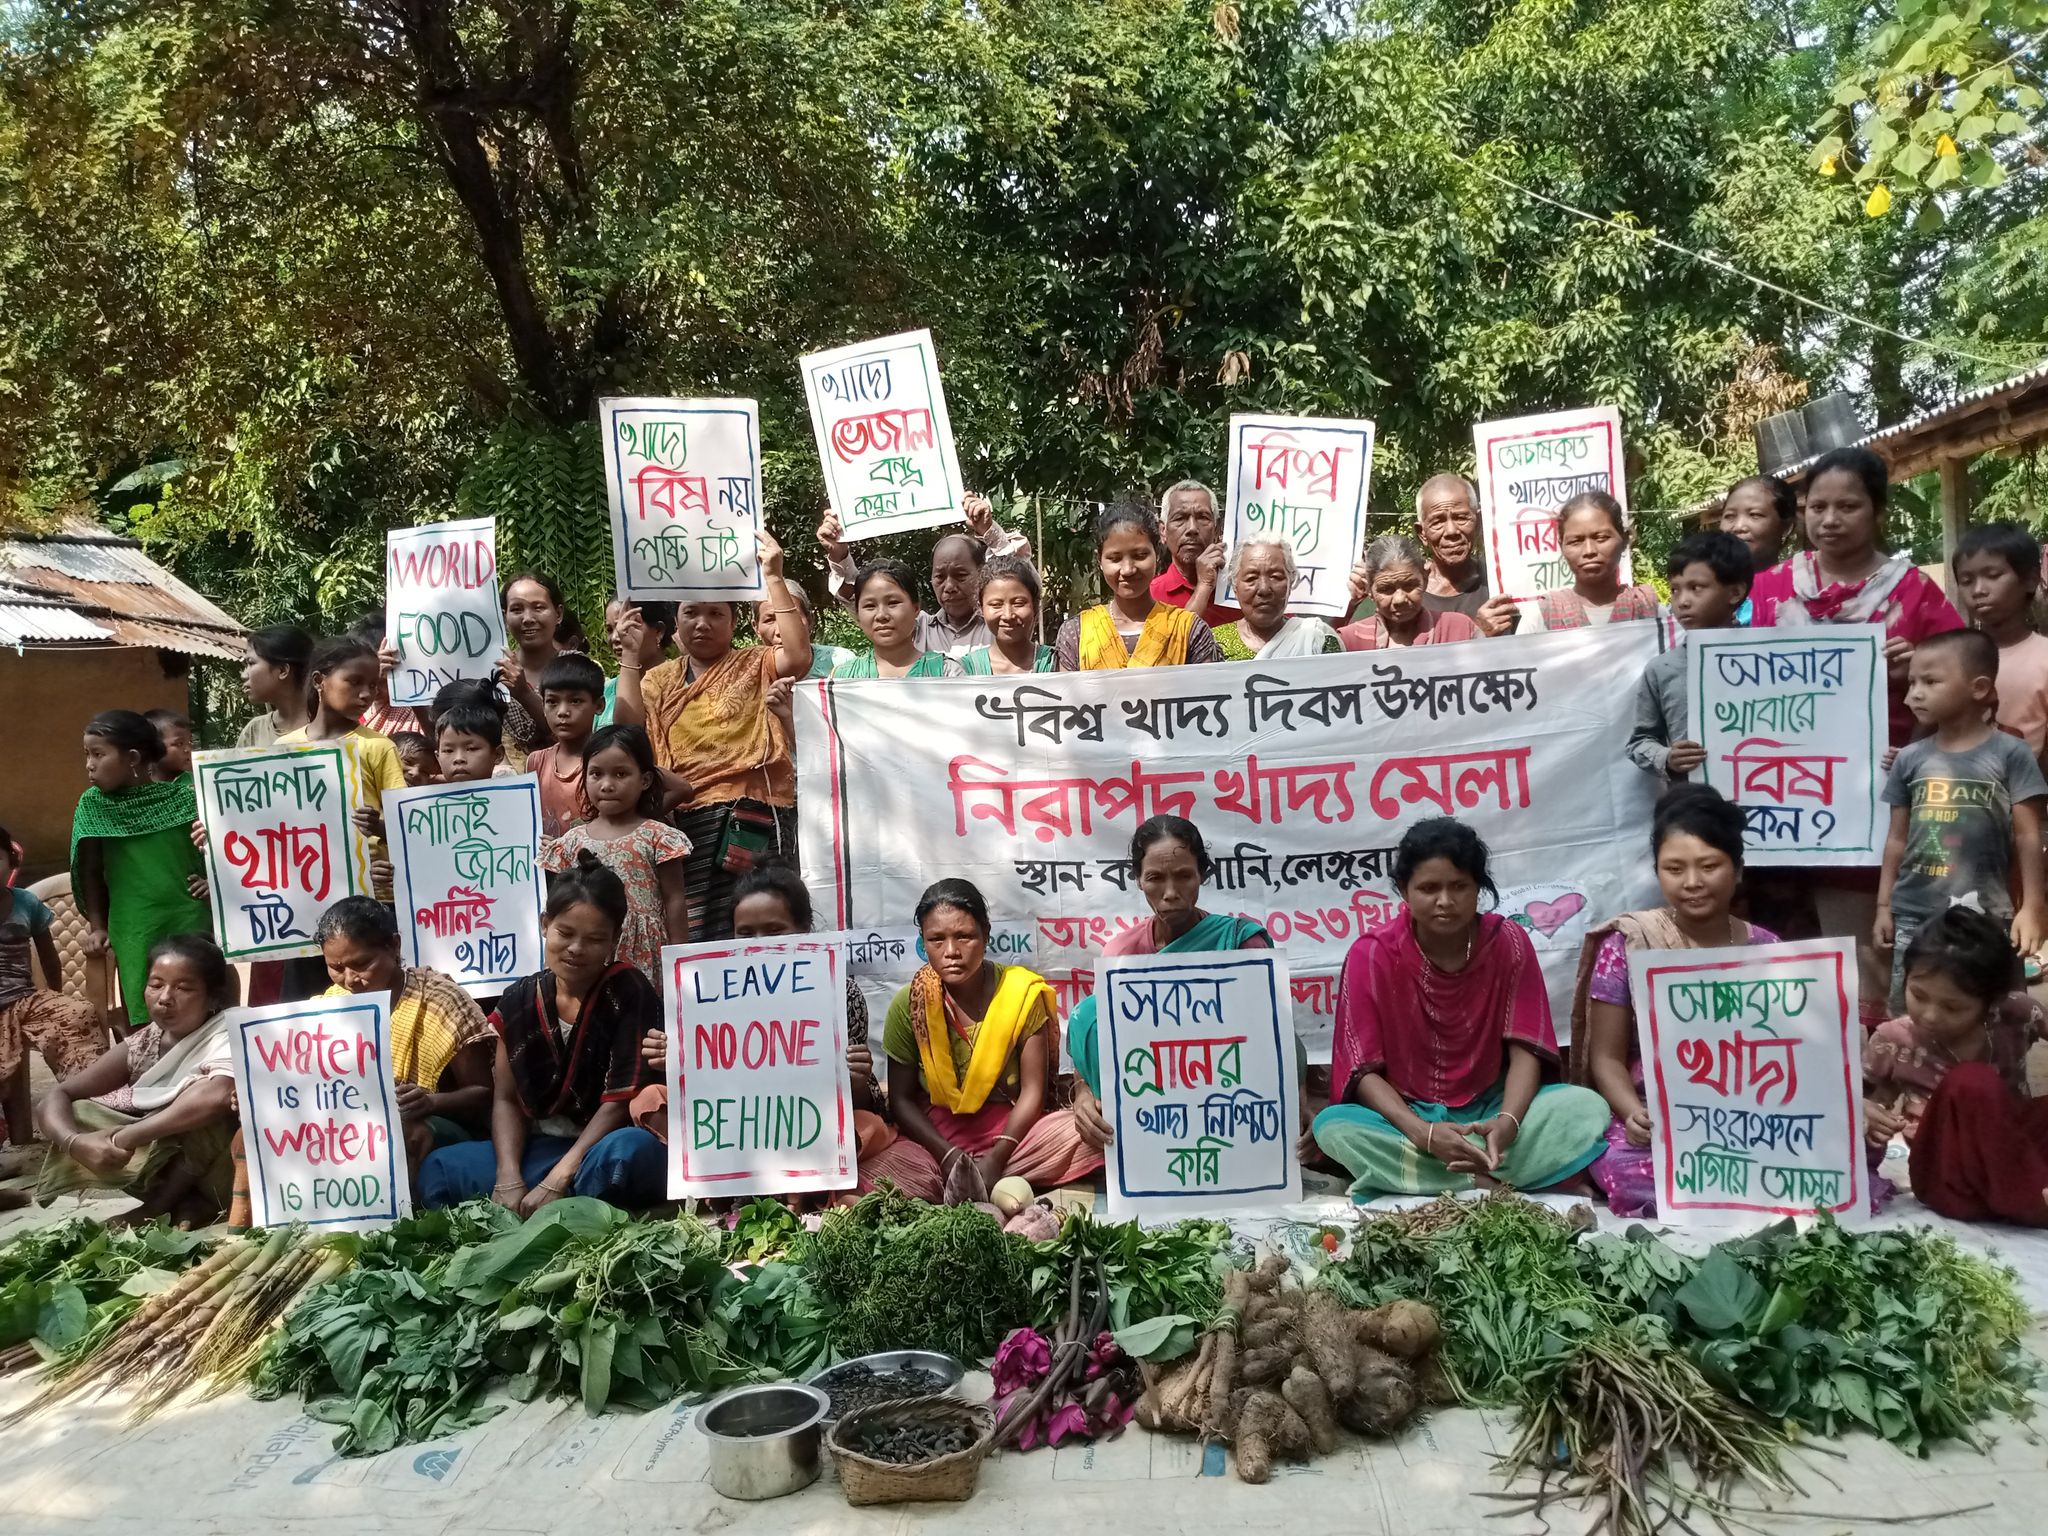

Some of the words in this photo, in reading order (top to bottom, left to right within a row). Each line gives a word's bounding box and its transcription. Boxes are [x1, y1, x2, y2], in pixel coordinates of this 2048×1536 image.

[820, 357, 892, 403] খাদ্যে
[619, 421, 688, 471] খাদ্যে
[831, 408, 934, 464] ভেজাল
[628, 464, 711, 521] বিষ
[717, 477, 752, 518] নয়
[1247, 430, 1354, 503] বিশ্ব
[392, 539, 495, 590] WORLD
[632, 524, 690, 583] পুষ্টি
[696, 518, 749, 578] চাই
[397, 611, 492, 661] FOOD
[406, 667, 461, 699] DAY
[1715, 647, 1856, 689] আমার
[1121, 693, 1232, 741] খাদ্য
[1244, 674, 1367, 732] দিবস
[1714, 691, 1837, 737] খাবারে
[213, 764, 328, 817] নিরাপদ
[948, 754, 1205, 843] নিরাপদ
[1213, 754, 1356, 825] খাদ্য
[1369, 746, 1532, 821] মেলা
[1721, 737, 1849, 806] বিষ
[1913, 780, 1994, 803] RBAN
[408, 793, 499, 847] পানিই
[224, 822, 331, 902] খাদ্য
[452, 837, 531, 891] জীবন
[241, 891, 311, 944] চাই
[416, 884, 499, 939] পানিই
[455, 931, 517, 976] খাদ্য
[846, 933, 905, 965] ারসিক
[984, 933, 1033, 954] RCIK
[694, 961, 815, 1004] LEAVE
[1118, 977, 1237, 1027] সকল
[695, 1022, 737, 1070] NO
[742, 1019, 820, 1070] ONE
[1123, 1036, 1247, 1097] প্রানের
[1676, 1030, 1802, 1105] খাদ্য
[693, 1095, 821, 1150] BEHIND
[1136, 1103, 1188, 1138] খাদ্য
[1198, 1088, 1279, 1143] নিশ্চিত
[1166, 1136, 1234, 1186] করি
[1675, 1142, 1758, 1197] এগিয়ে
[1761, 1166, 1845, 1206] আসুন
[313, 1174, 385, 1210] FOOD.
